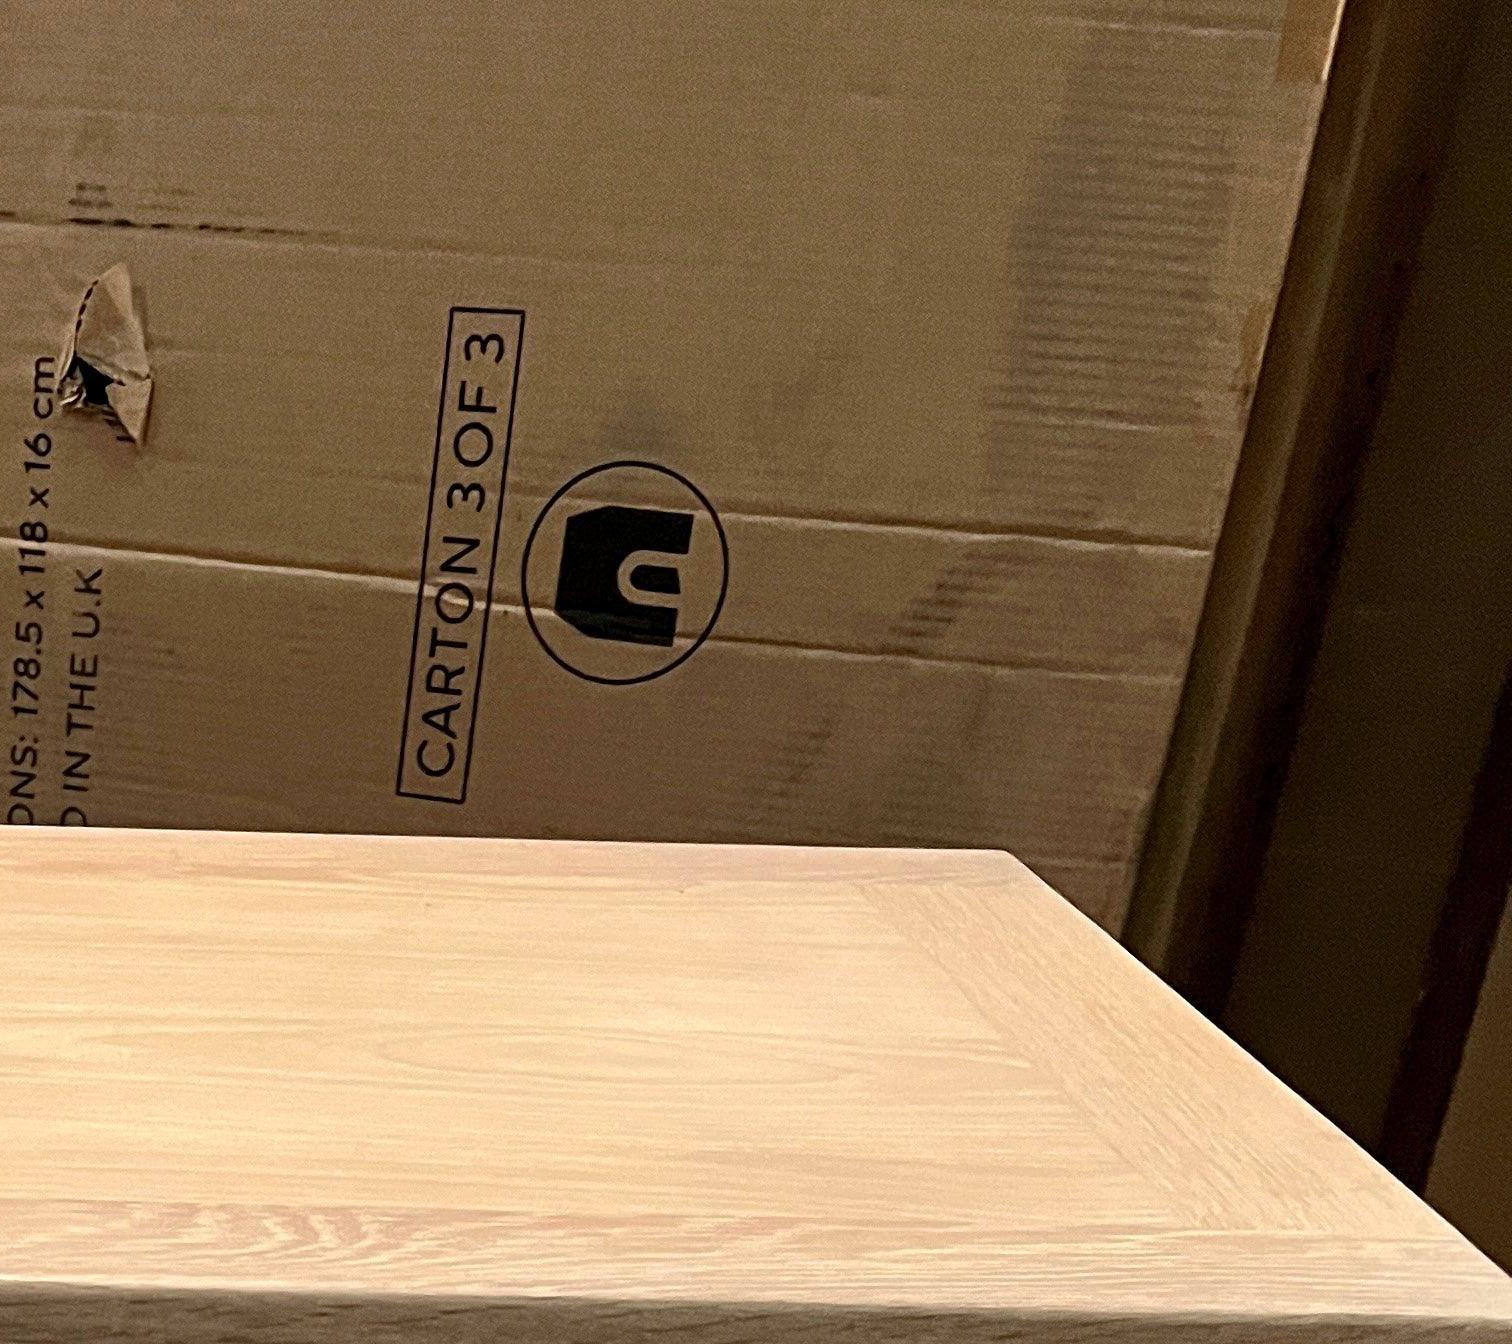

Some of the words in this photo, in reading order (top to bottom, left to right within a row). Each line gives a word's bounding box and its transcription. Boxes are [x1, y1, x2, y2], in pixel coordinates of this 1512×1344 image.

[463, 333, 505, 364] 3
[33, 357, 55, 420] cm
[453, 380, 498, 468] OF
[23, 432, 52, 474] 16
[28, 487, 50, 509] x
[446, 482, 486, 513] 3
[18, 521, 51, 576] 118
[24, 590, 45, 610] x
[70, 568, 102, 638] U.K
[10, 621, 44, 717] 178.5
[416, 535, 481, 778] CARTON
[65, 653, 98, 737] THE
[62, 750, 92, 792] IN
